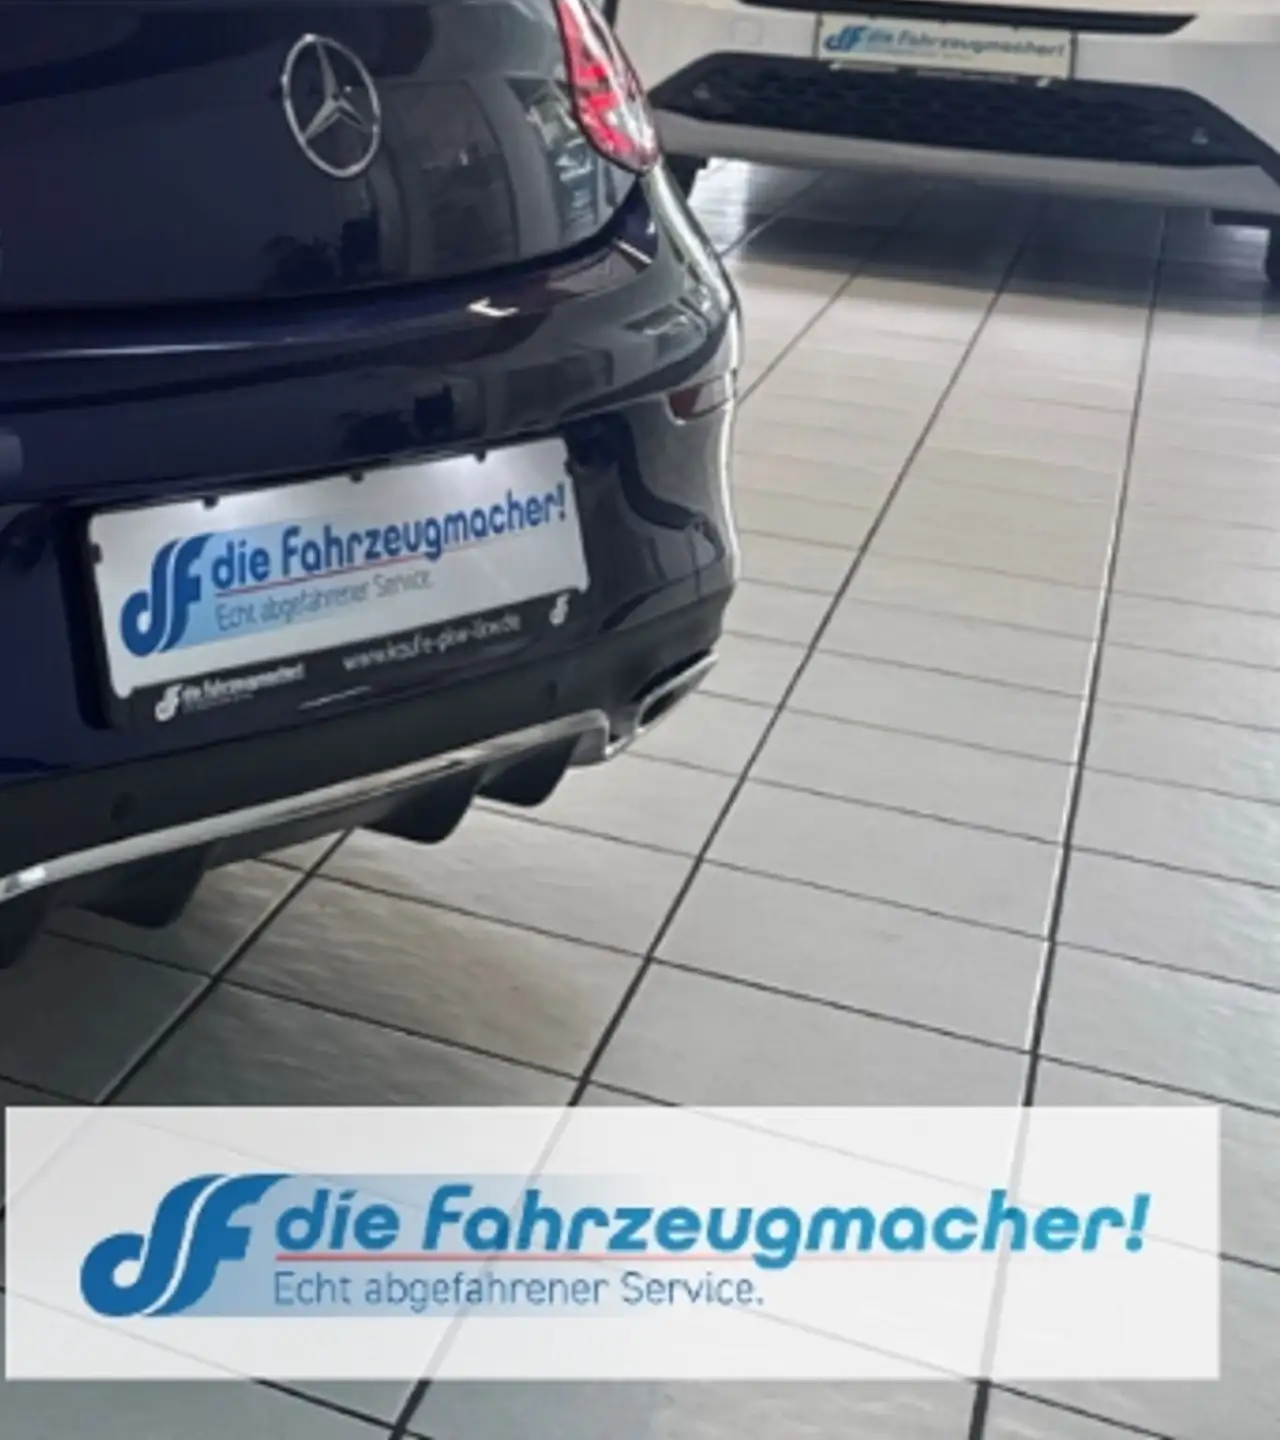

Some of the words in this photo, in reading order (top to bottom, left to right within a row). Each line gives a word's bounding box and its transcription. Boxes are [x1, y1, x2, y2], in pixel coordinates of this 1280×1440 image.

[211, 541, 271, 589] die
[282, 483, 567, 578] Fahrzeugmacher!
[216, 601, 256, 632] Echt
